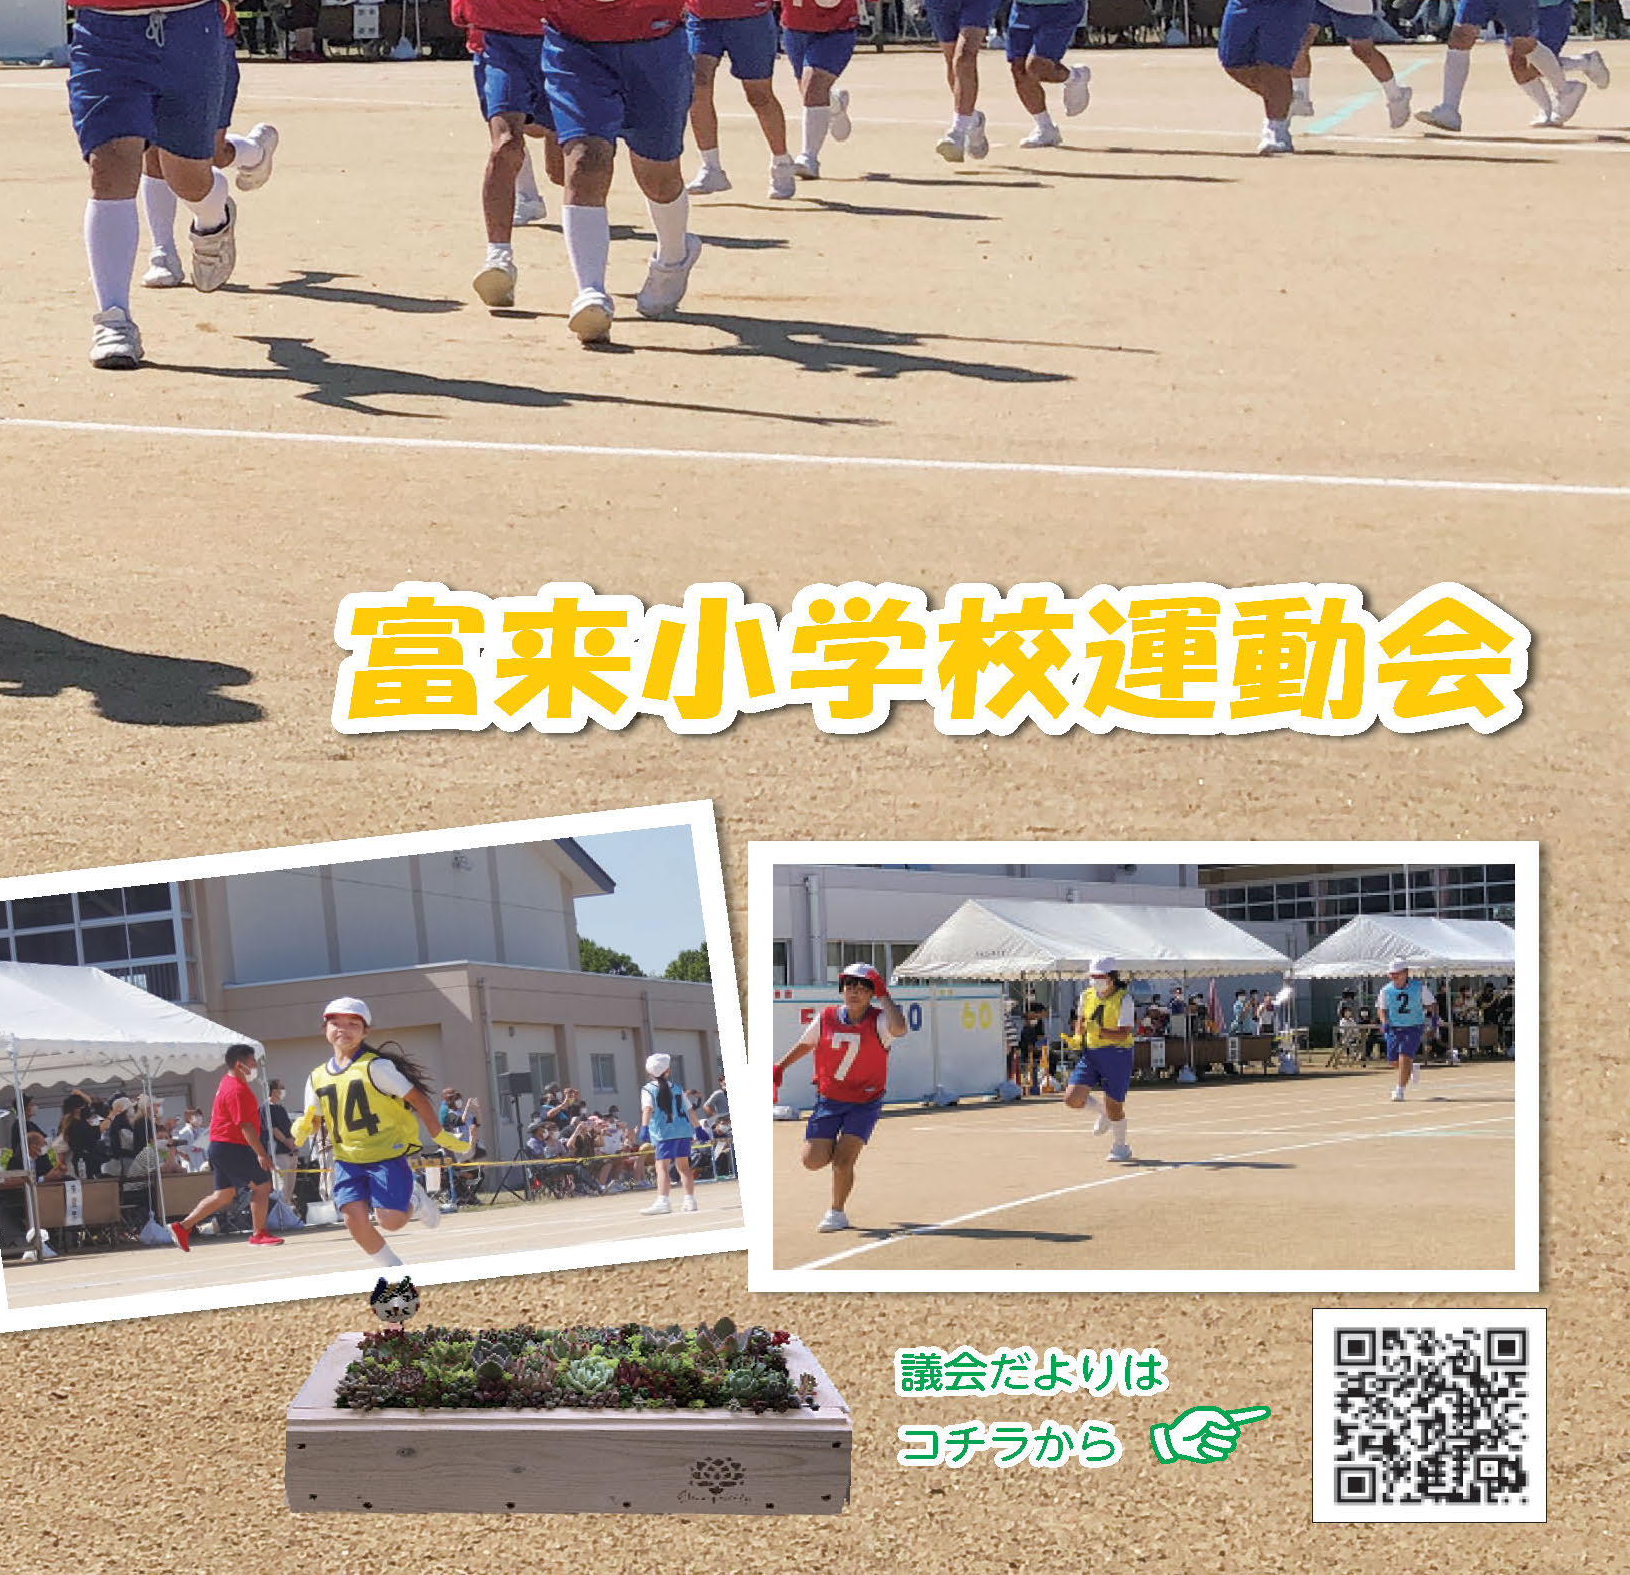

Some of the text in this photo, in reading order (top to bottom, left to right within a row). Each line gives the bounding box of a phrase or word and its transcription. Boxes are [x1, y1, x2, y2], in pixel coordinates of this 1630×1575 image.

[961, 1001, 992, 1030] 60
[1396, 993, 1411, 1014] 2
[831, 1032, 861, 1081] 7
